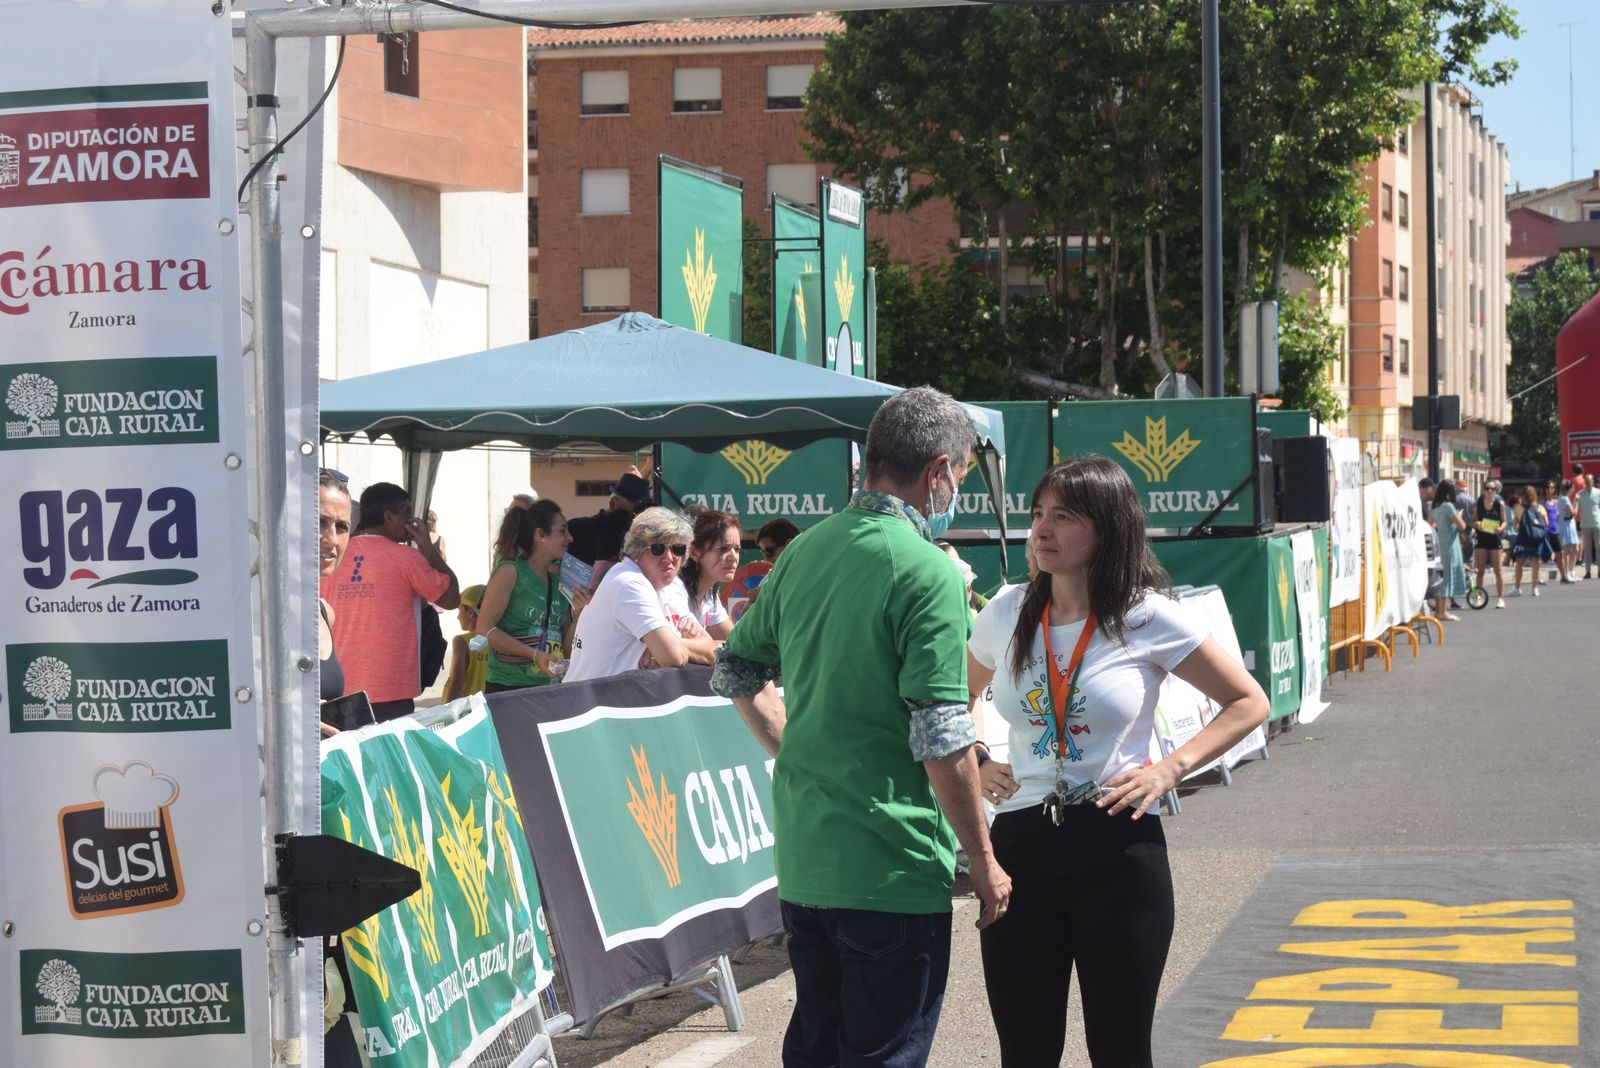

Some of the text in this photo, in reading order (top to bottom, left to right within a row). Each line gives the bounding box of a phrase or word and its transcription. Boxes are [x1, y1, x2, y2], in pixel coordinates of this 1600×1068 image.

[28, 123, 195, 149] DIPUTACIÓN DE
[27, 147, 199, 186] ZAMORA
[69, 311, 136, 329] Zamora
[64, 389, 204, 414] FUNDACION
[65, 413, 204, 437] CAJA RURAL
[747, 494, 833, 515] RURAL
[1148, 490, 1239, 513] RURAL
[19, 486, 199, 590] gaza
[26, 594, 200, 613] Ganaderos de Zamora
[76, 676, 215, 700] FUNDACION
[77, 700, 216, 724] CAJA RURAL
[685, 764, 775, 865] CAJA
[72, 829, 167, 890] Susi
[78, 881, 170, 905] delicias del gourmet
[86, 982, 230, 1006] FUNDACION
[86, 1004, 231, 1030] CAJA RURAL
